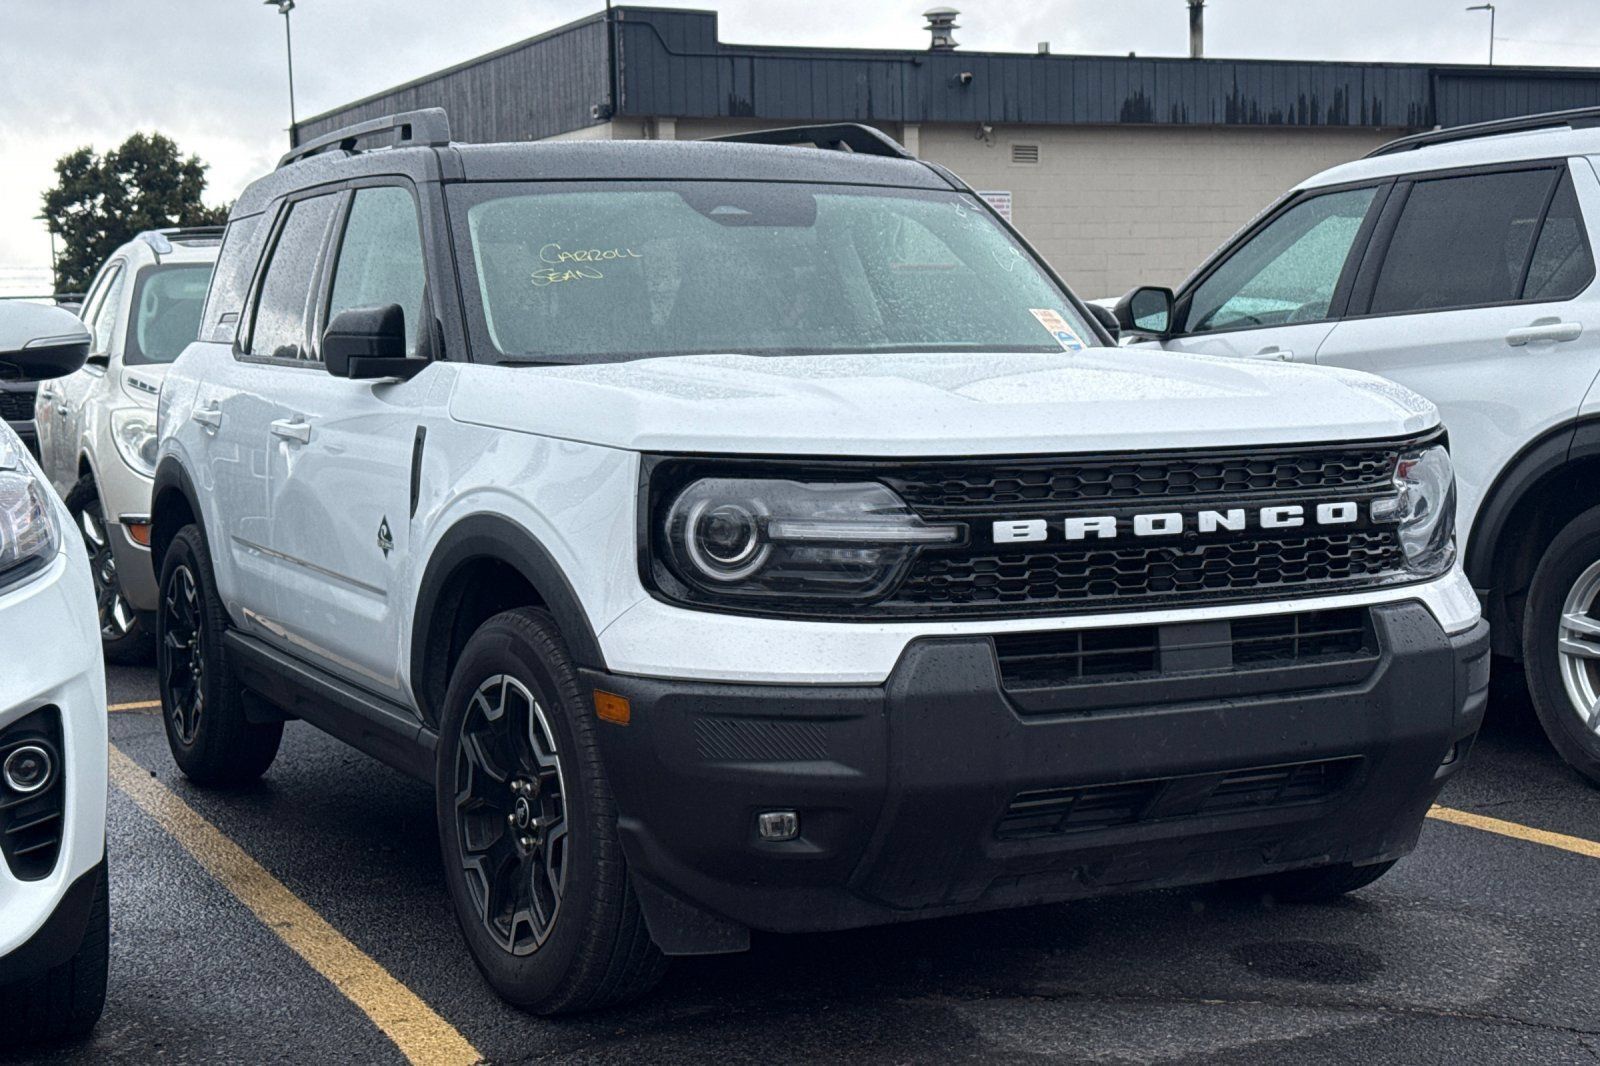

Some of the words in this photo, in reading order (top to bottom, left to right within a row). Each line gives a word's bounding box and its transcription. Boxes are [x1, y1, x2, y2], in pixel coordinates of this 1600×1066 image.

[539, 244, 642, 264] CARROLL
[531, 267, 603, 286] SEAN
[993, 502, 1358, 544] BRONCO
